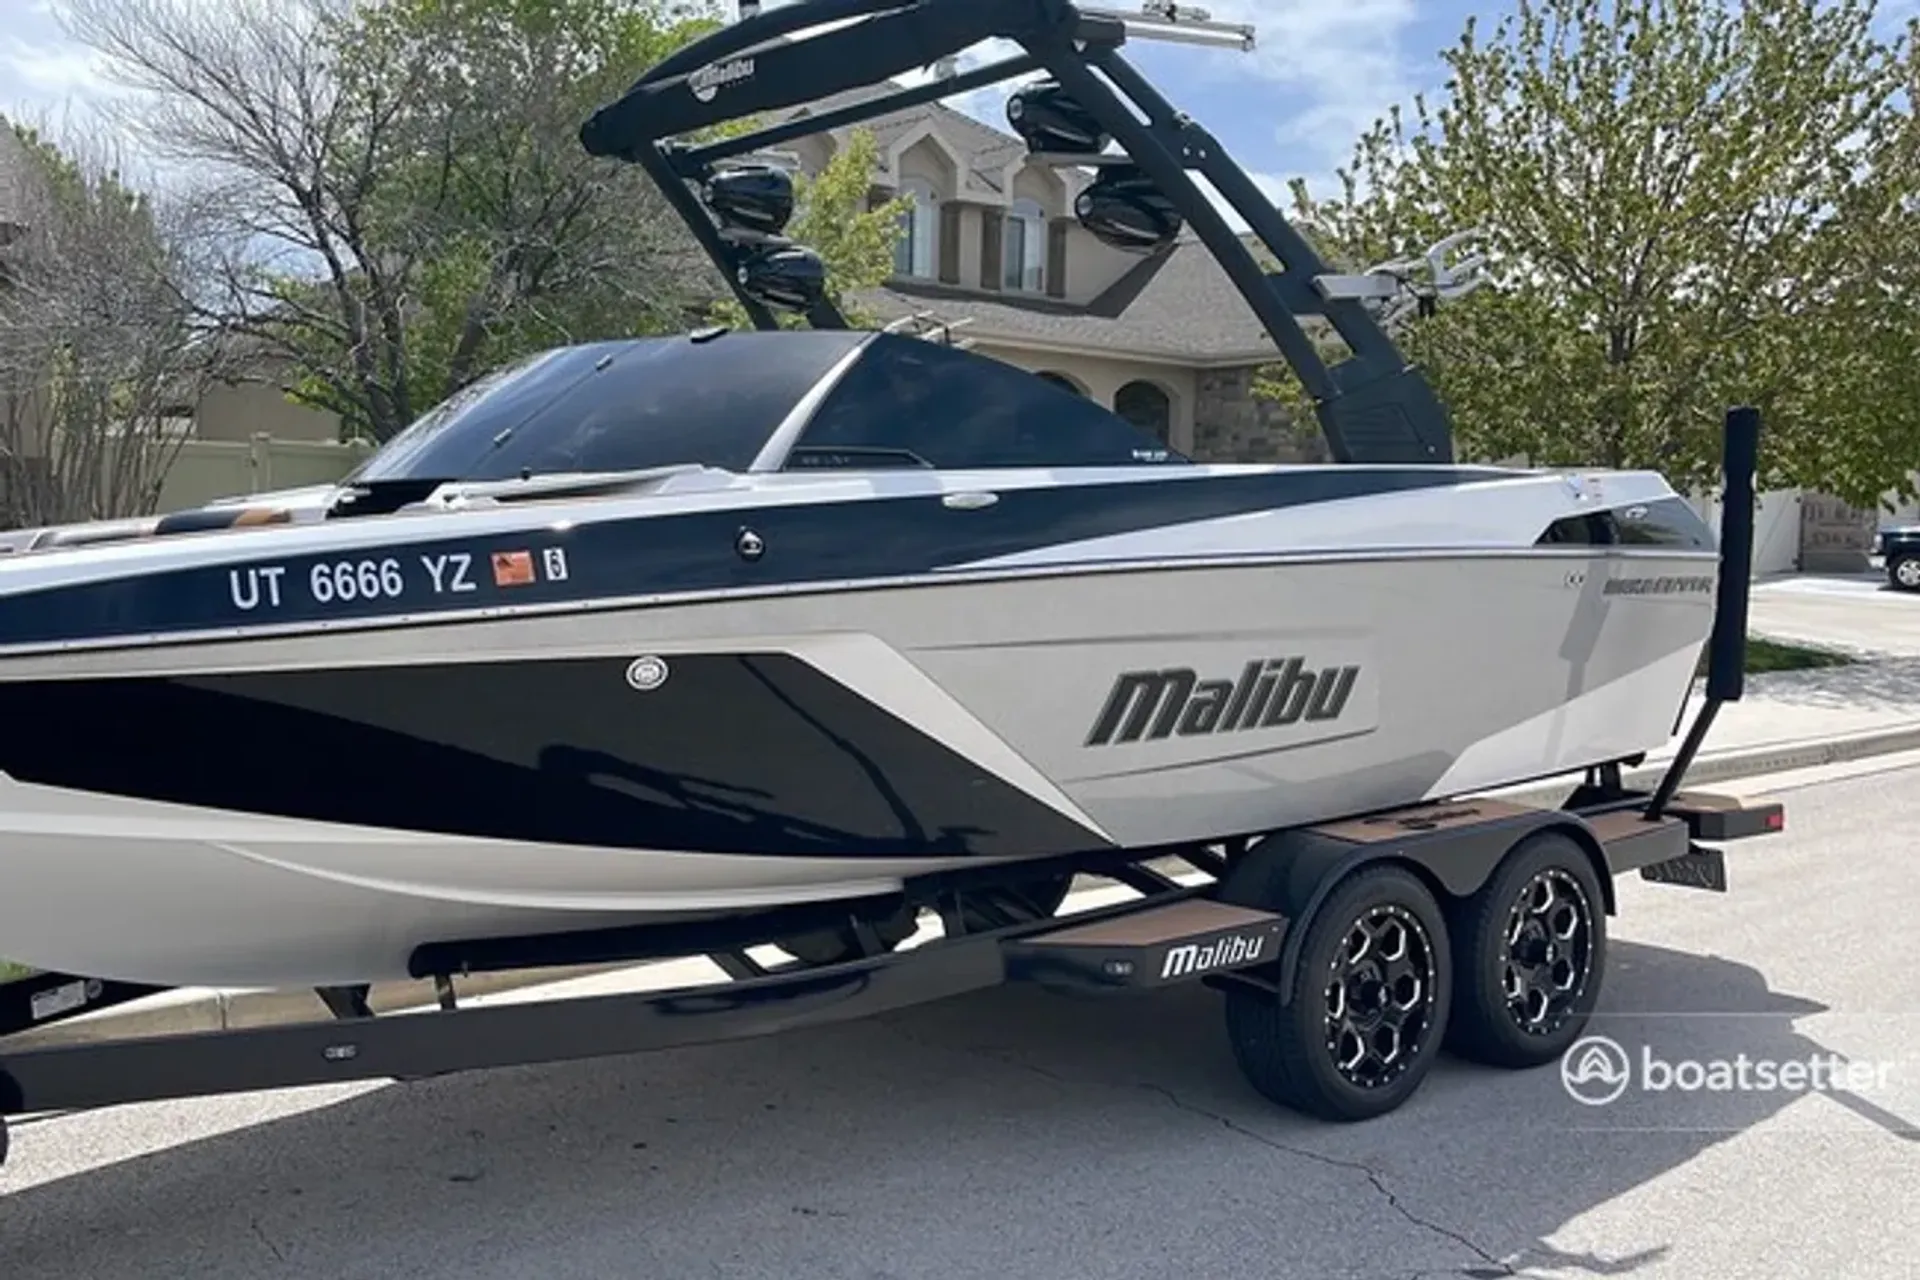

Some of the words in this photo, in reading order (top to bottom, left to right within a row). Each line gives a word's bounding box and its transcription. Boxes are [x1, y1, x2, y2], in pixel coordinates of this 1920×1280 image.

[230, 567, 285, 610] UT
[310, 559, 404, 603] 6666
[421, 554, 477, 593] YZ
[1083, 656, 1361, 748] Malibu
[1160, 935, 1264, 978] Malibu
